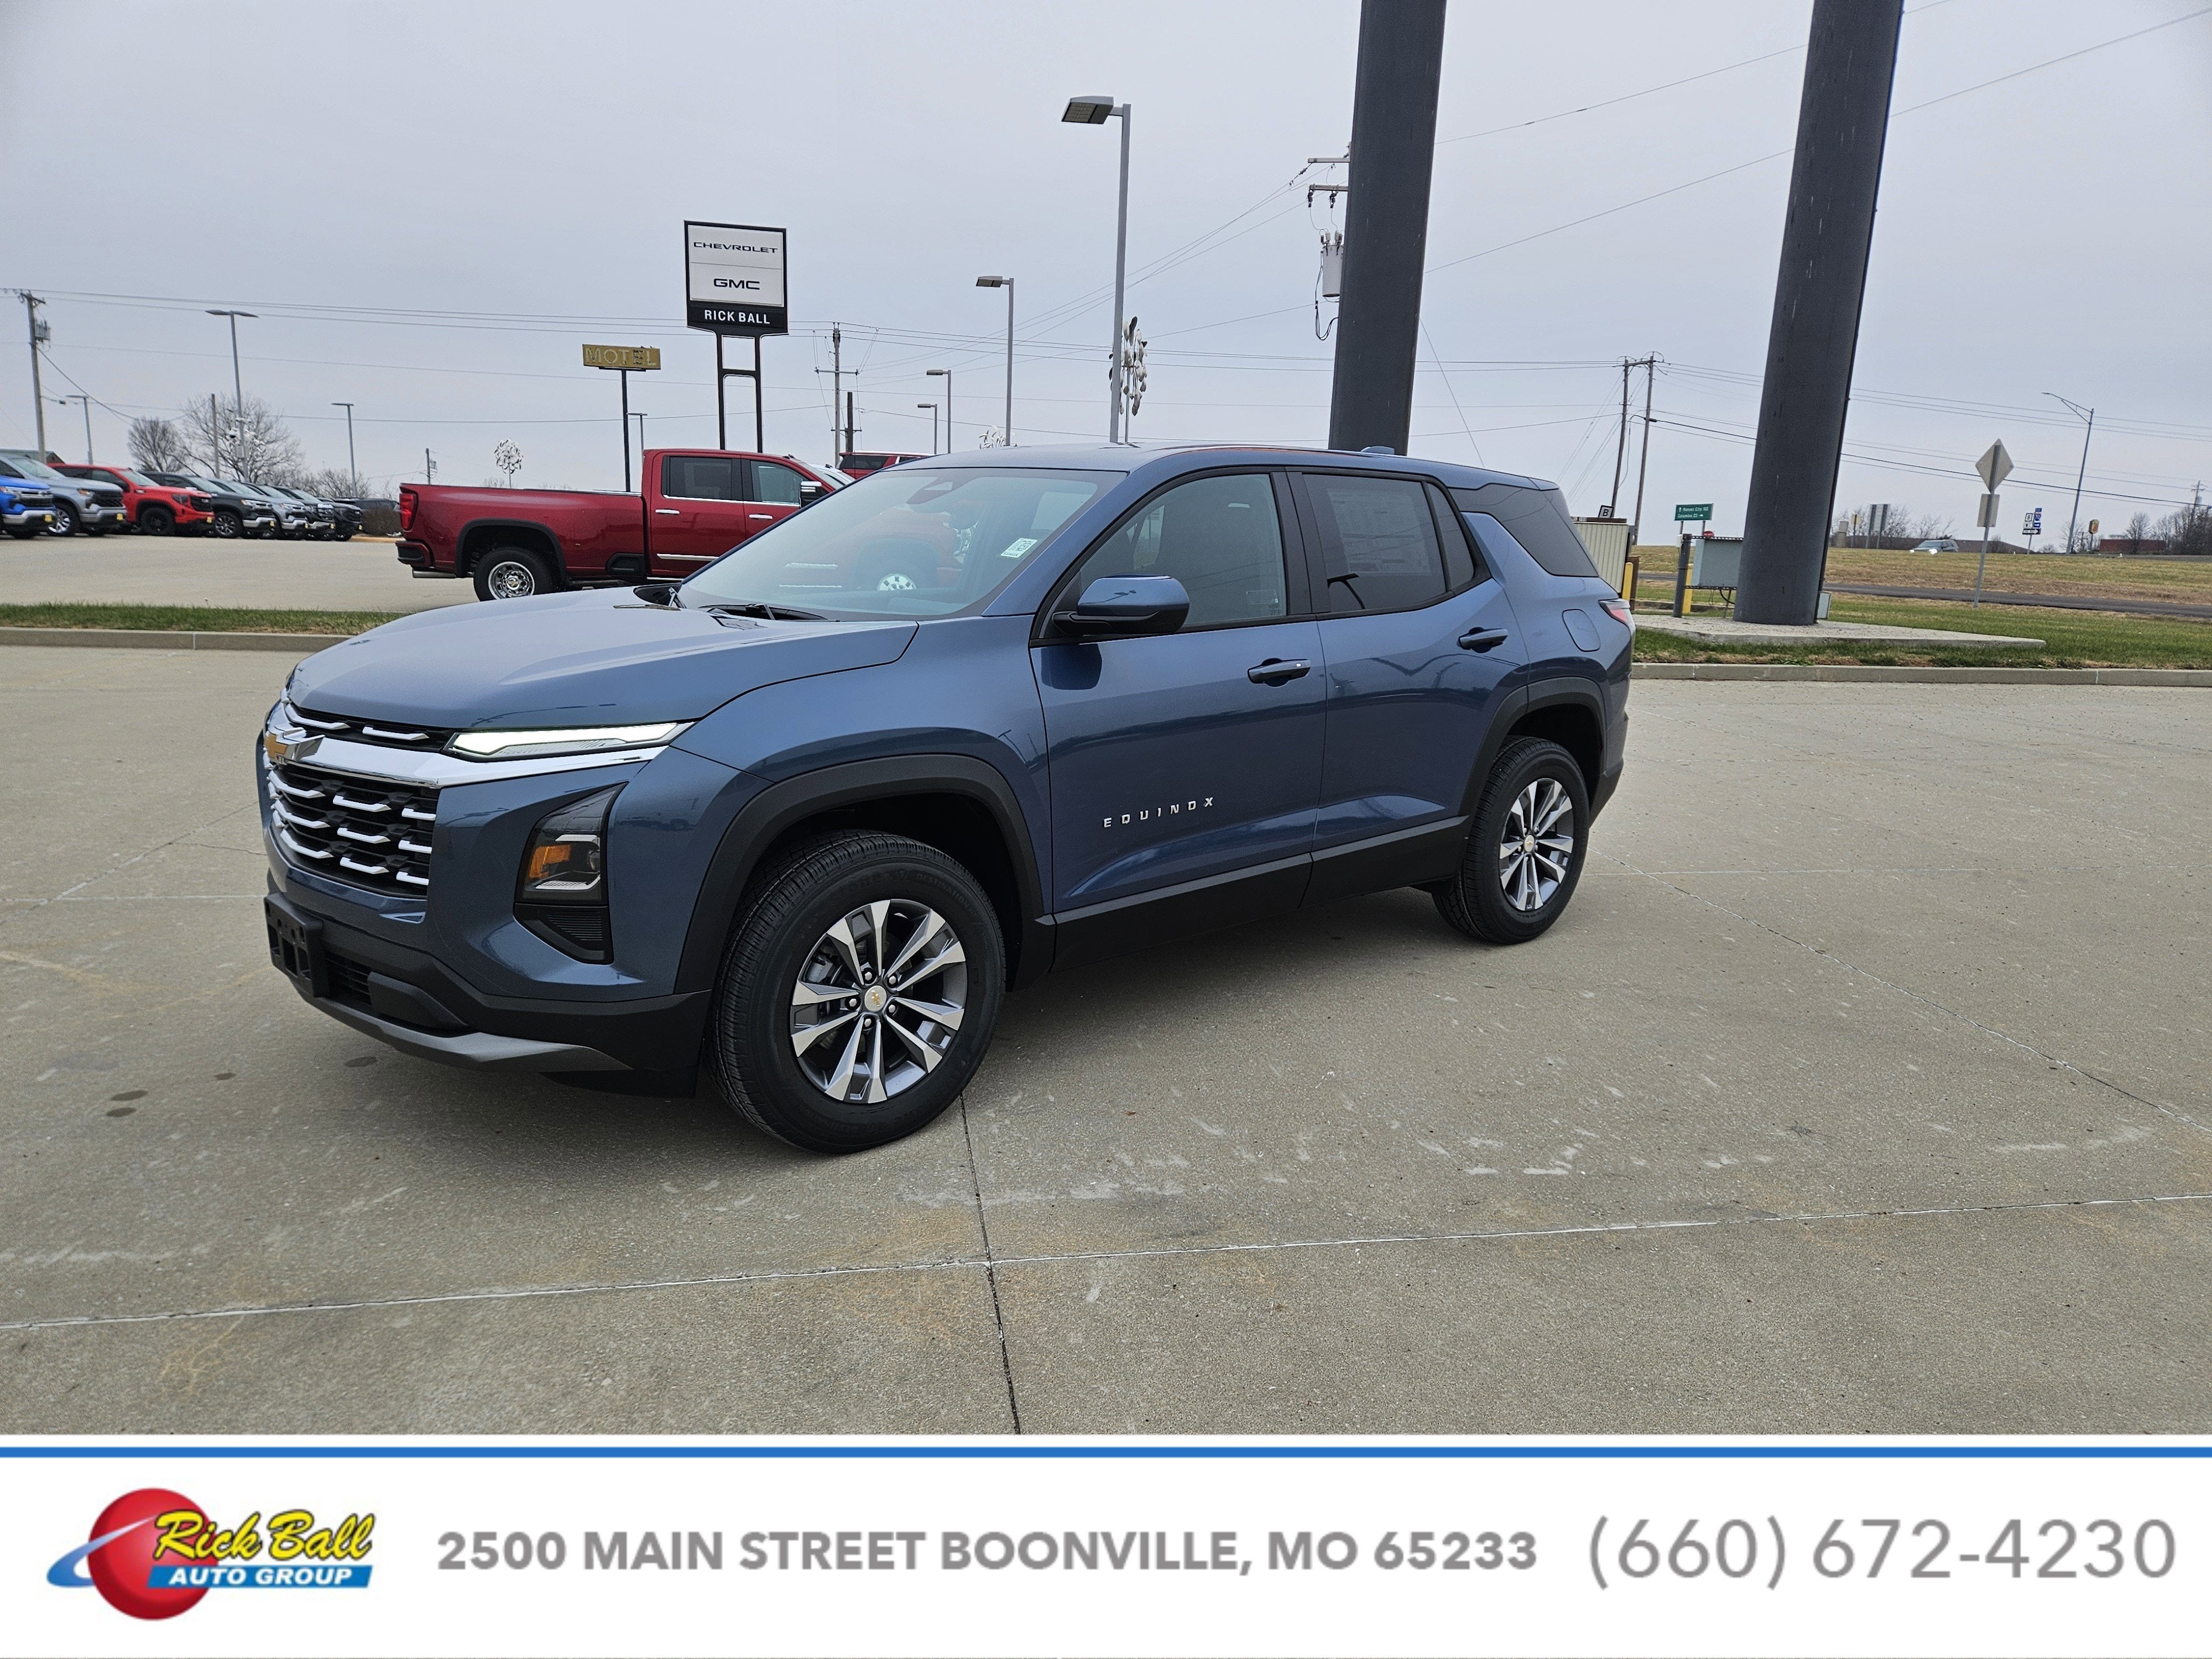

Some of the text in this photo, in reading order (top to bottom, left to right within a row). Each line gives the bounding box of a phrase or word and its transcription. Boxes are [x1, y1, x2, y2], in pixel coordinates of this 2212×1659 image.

[693, 242, 778, 253] CHEVROLET
[713, 278, 760, 290] GMC
[704, 309, 770, 325] RICK BALL
[585, 347, 656, 366] MOTEL
[1103, 797, 1214, 828] EQUINOX
